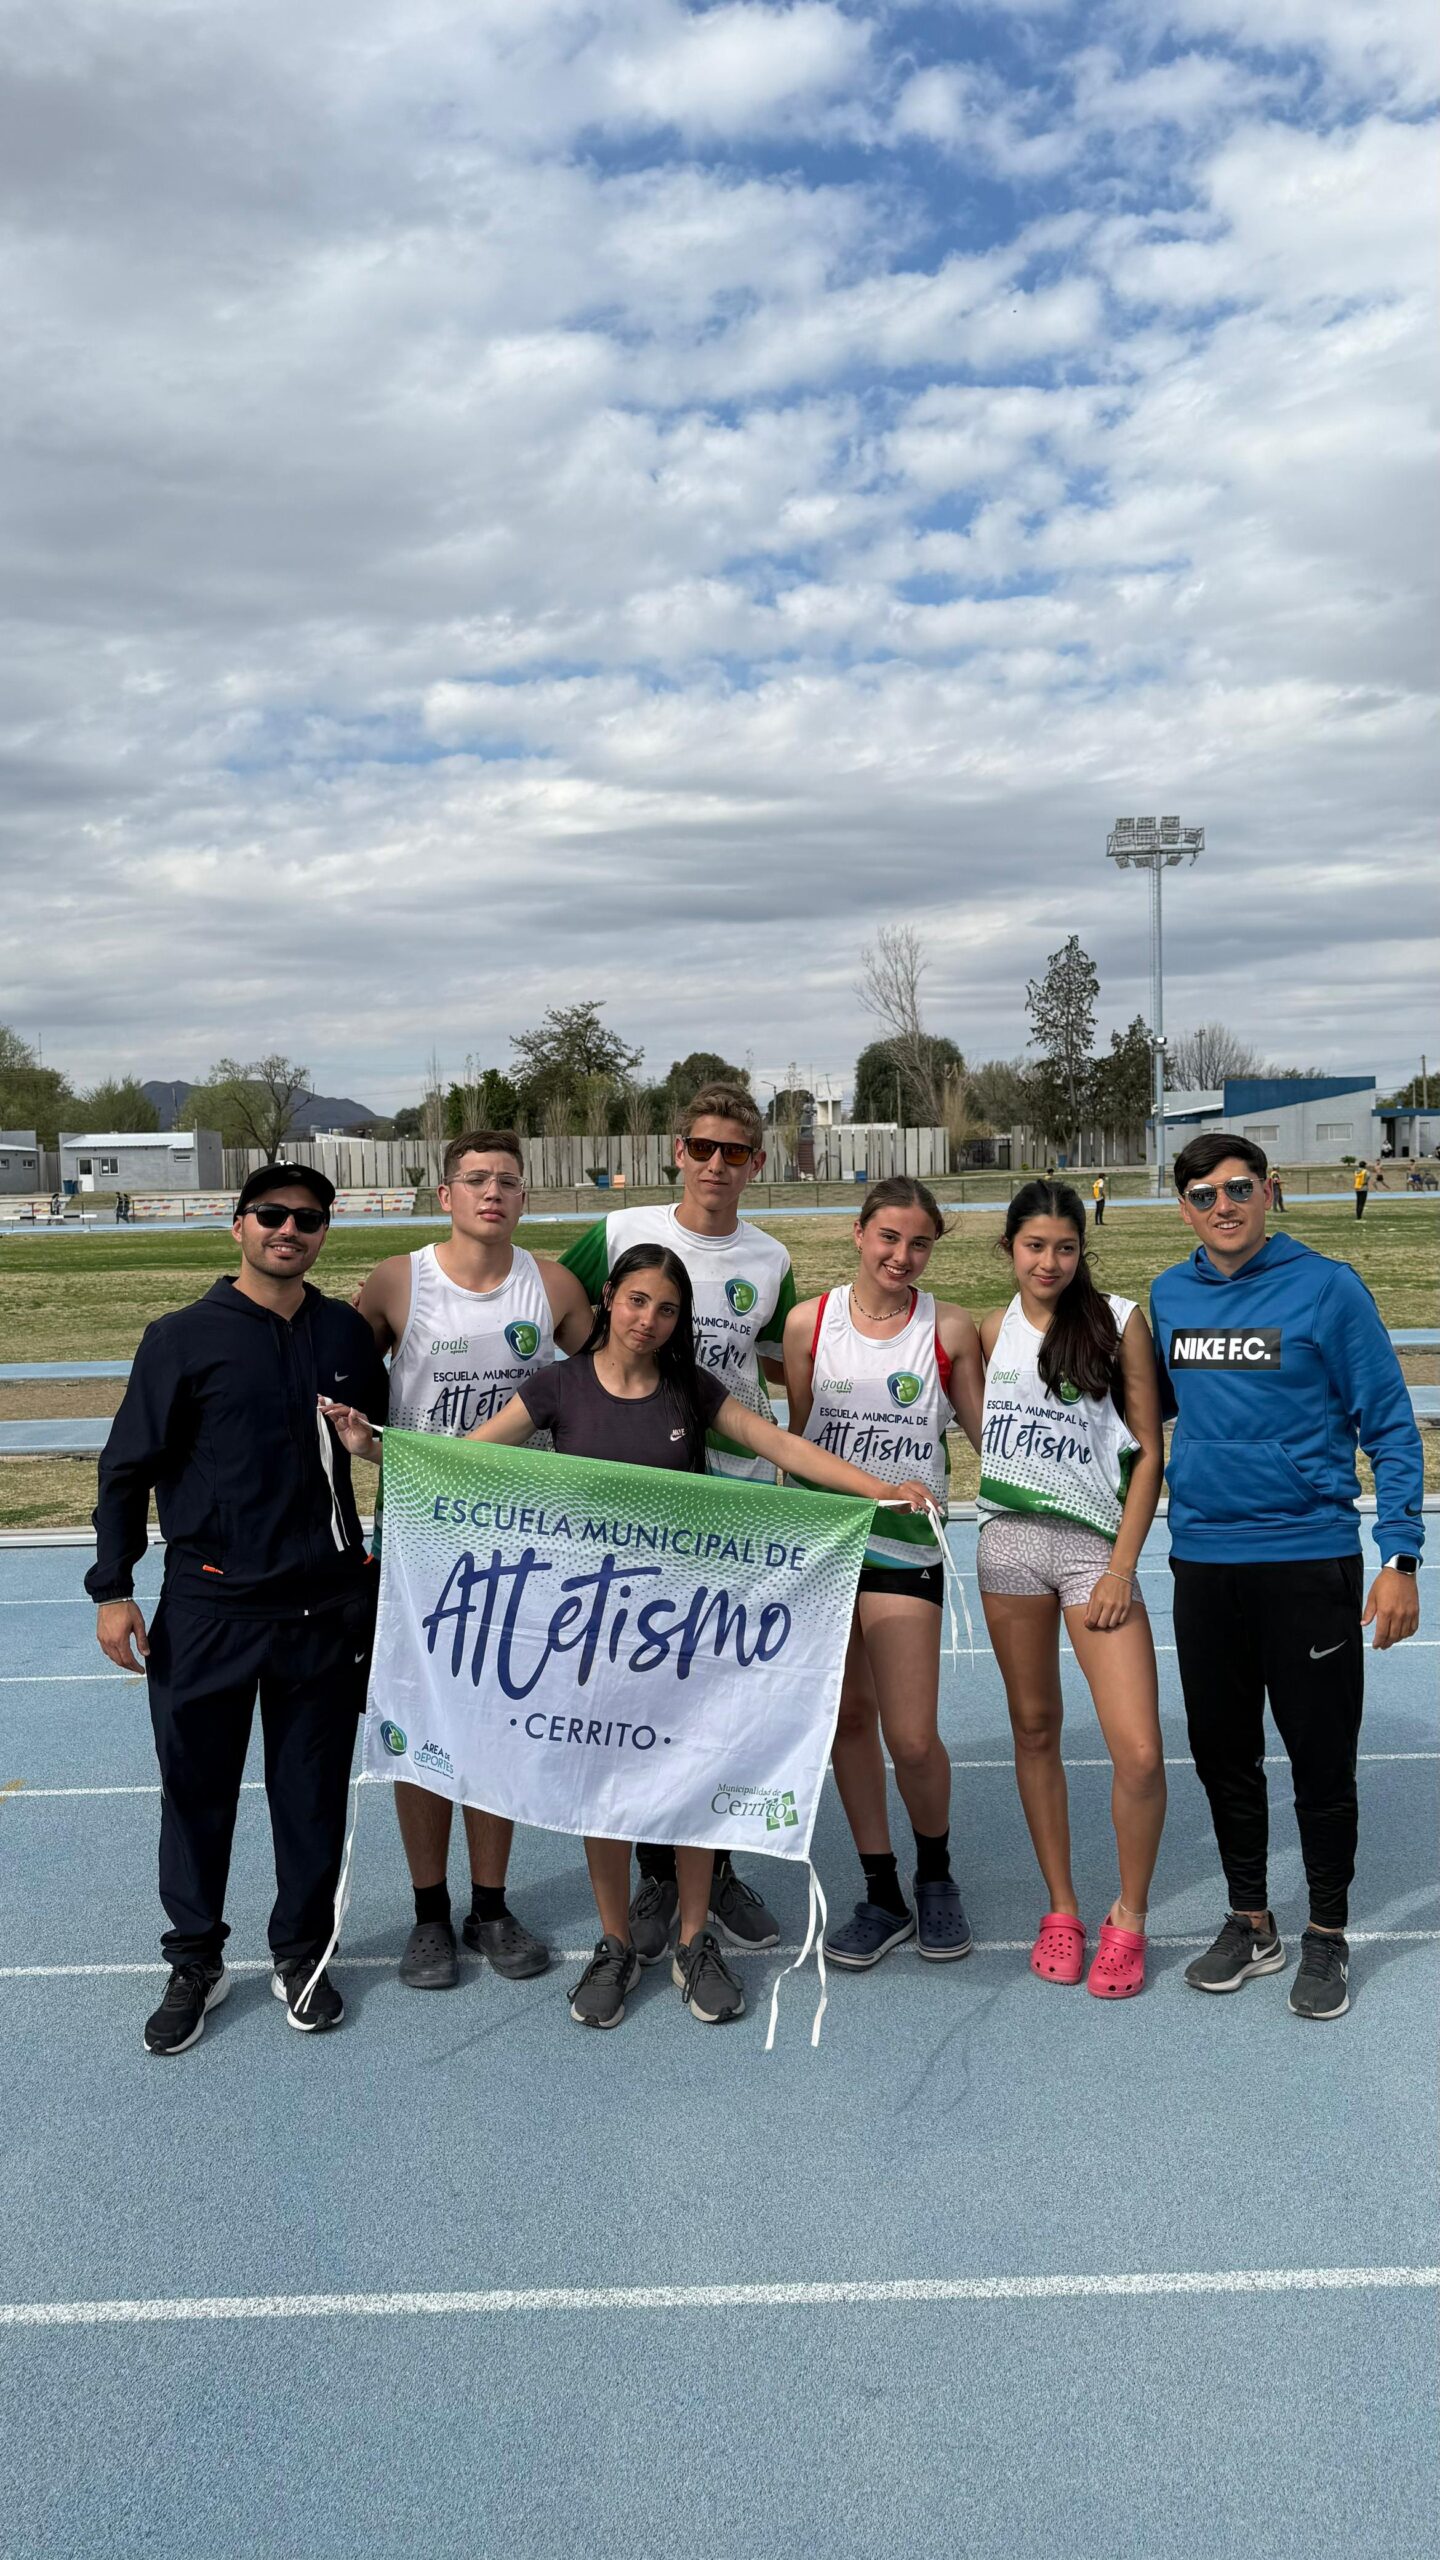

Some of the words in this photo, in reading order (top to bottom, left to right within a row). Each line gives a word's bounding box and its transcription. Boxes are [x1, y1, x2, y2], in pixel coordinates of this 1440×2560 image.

[692, 1316, 738, 1332] MUNICIPAL
[740, 1325, 751, 1335] DE
[430, 1336, 469, 1355] goals
[1173, 1338, 1226, 1360] NIKE
[1228, 1337, 1271, 1361] F.C.
[433, 1371, 480, 1382] ESCUELA
[820, 1378, 854, 1391] goals
[427, 1383, 513, 1431] Atleti
[820, 1407, 859, 1420] ESCUELA
[862, 1412, 914, 1425] MUNICIPAL
[916, 1417, 928, 1426] DE
[986, 1400, 1022, 1412] ESCUELA
[1025, 1406, 1077, 1425] MUNICIPAL
[433, 1496, 572, 1539] ESCUELA
[581, 1518, 755, 1564] MUNICIPAL
[765, 1543, 806, 1571] DE
[422, 1547, 792, 1700] Atletismo
[525, 1713, 656, 1750] CERRITO
[422, 1740, 444, 1757] ÁREA
[414, 1751, 453, 1774] DEPORTES
[717, 1783, 771, 1796] Municipalidad
[772, 1788, 781, 1797] de
[711, 1791, 787, 1819] Cerrito
